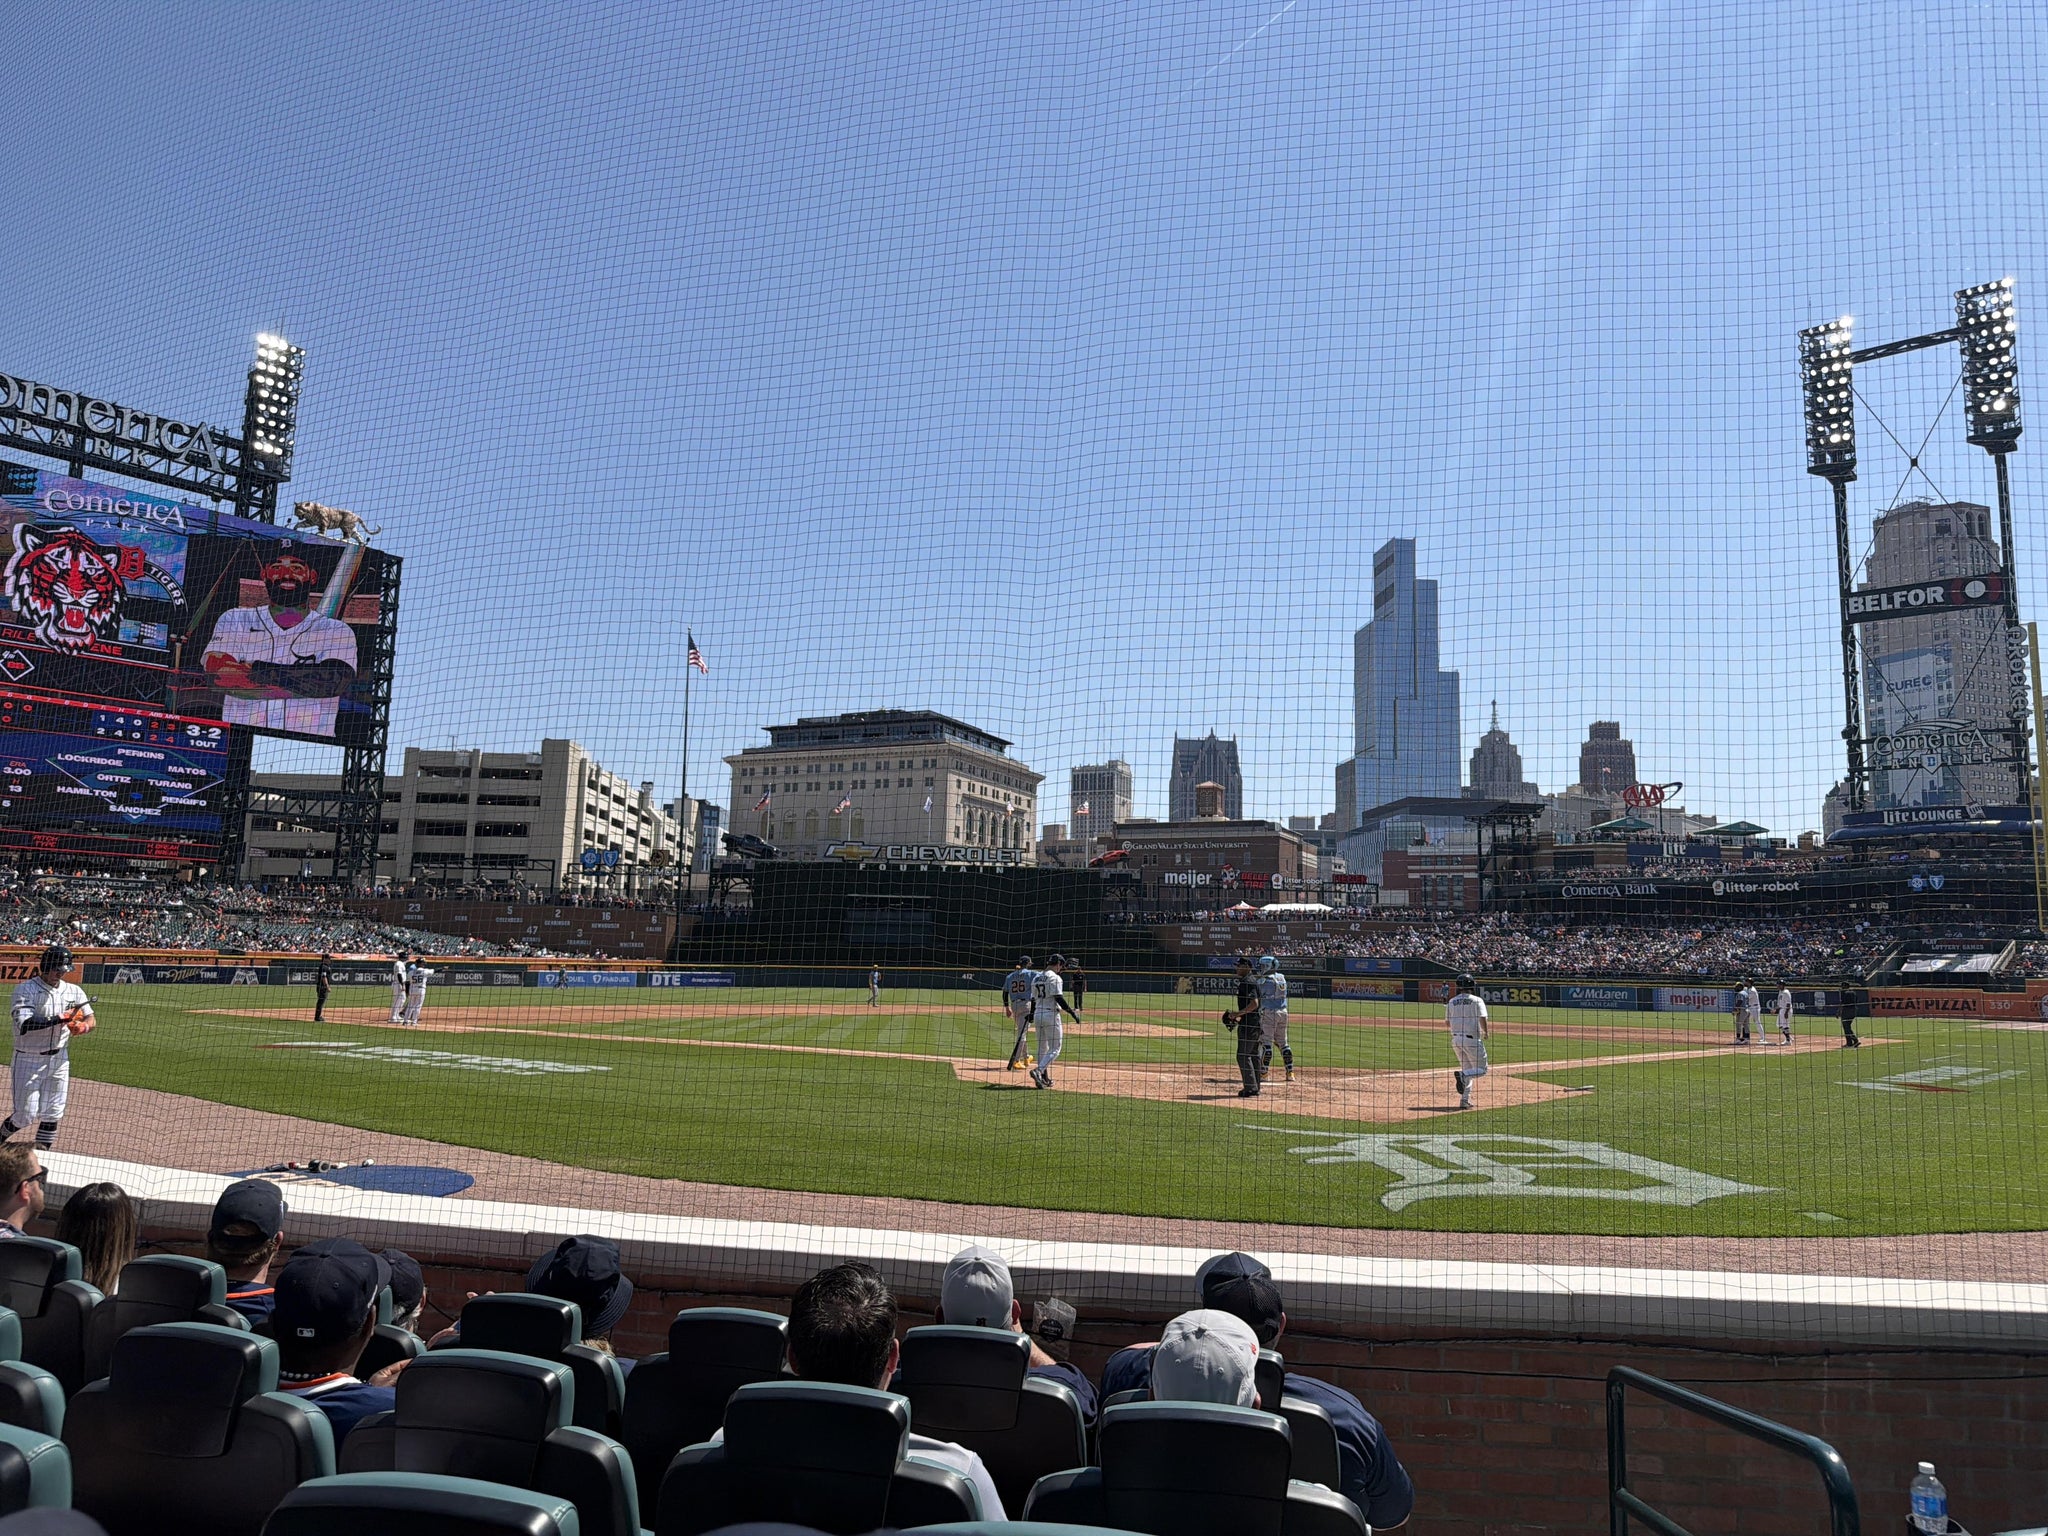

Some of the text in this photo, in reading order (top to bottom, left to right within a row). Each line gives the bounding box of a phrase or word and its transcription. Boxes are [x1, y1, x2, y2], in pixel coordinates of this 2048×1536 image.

[15, 417, 151, 468] PARK
[86, 518, 149, 534] PARK
[150, 566, 185, 606] TIGERS
[1849, 586, 1945, 615] BELFOR
[1886, 678, 1920, 692] CURE
[2008, 644, 2033, 719] Rocket
[114, 729, 123, 737] 4
[115, 716, 125, 724] 4
[151, 721, 159, 729] 2
[186, 724, 222, 740] 3-2
[1873, 729, 1989, 756] ComericA
[57, 752, 124, 767] LOCKRIDGE
[117, 748, 165, 760] PERKINS
[9, 760, 27, 768] ERA
[1875, 751, 1992, 771] LANDING
[3, 766, 32, 776] 3.00
[168, 765, 207, 776] MATOS
[97, 773, 132, 784] ORTIZ
[148, 778, 193, 790] TURANG
[9, 785, 23, 793] 13
[57, 785, 118, 798] HAMILTON
[161, 795, 207, 806] RENGIFO
[1911, 809, 1963, 821] LOUNGE
[35, 840, 57, 848] TYPE
[1132, 842, 1158, 850] GRAND
[1158, 842, 1182, 850] VALLEY
[1205, 841, 1250, 849] UNIVERSITY
[886, 845, 1027, 863] CHEVROLET
[1644, 857, 1705, 865] PITCHER'S PUB
[859, 863, 1004, 874] FOUNTAIN
[1164, 869, 1213, 889] meijer
[1241, 872, 1270, 881] BELLE
[1284, 876, 1323, 885] litter-robot
[71, 879, 144, 888] CHEVROLET
[1244, 881, 1265, 889] TIRE
[1725, 880, 1800, 893] litter-robot
[1562, 883, 1659, 898] ComericA Bank
[408, 903, 421, 913] 23
[507, 906, 513, 915] 5
[555, 909, 561, 918] 2
[602, 911, 611, 921] 16
[651, 915, 657, 924] 6
[526, 925, 538, 935] 47
[1277, 924, 1286, 933] 10
[1314, 922, 1323, 932] 11
[1349, 923, 1361, 932] 42
[576, 929, 583, 938] 3
[200, 970, 218, 979] TIME
[411, 974, 424, 984] 56
[455, 972, 484, 980] BIGGBY
[651, 974, 681, 986] DTE
[1011, 980, 1026, 993] 26
[1196, 977, 1241, 989] FERRIS
[1337, 983, 1376, 995] Surfside
[1584, 988, 1628, 1000] McLaren
[1479, 986, 1541, 1004] bet365
[1669, 991, 1717, 1010] meijer
[1871, 996, 1977, 1011] PIZZA! PIZZA!
